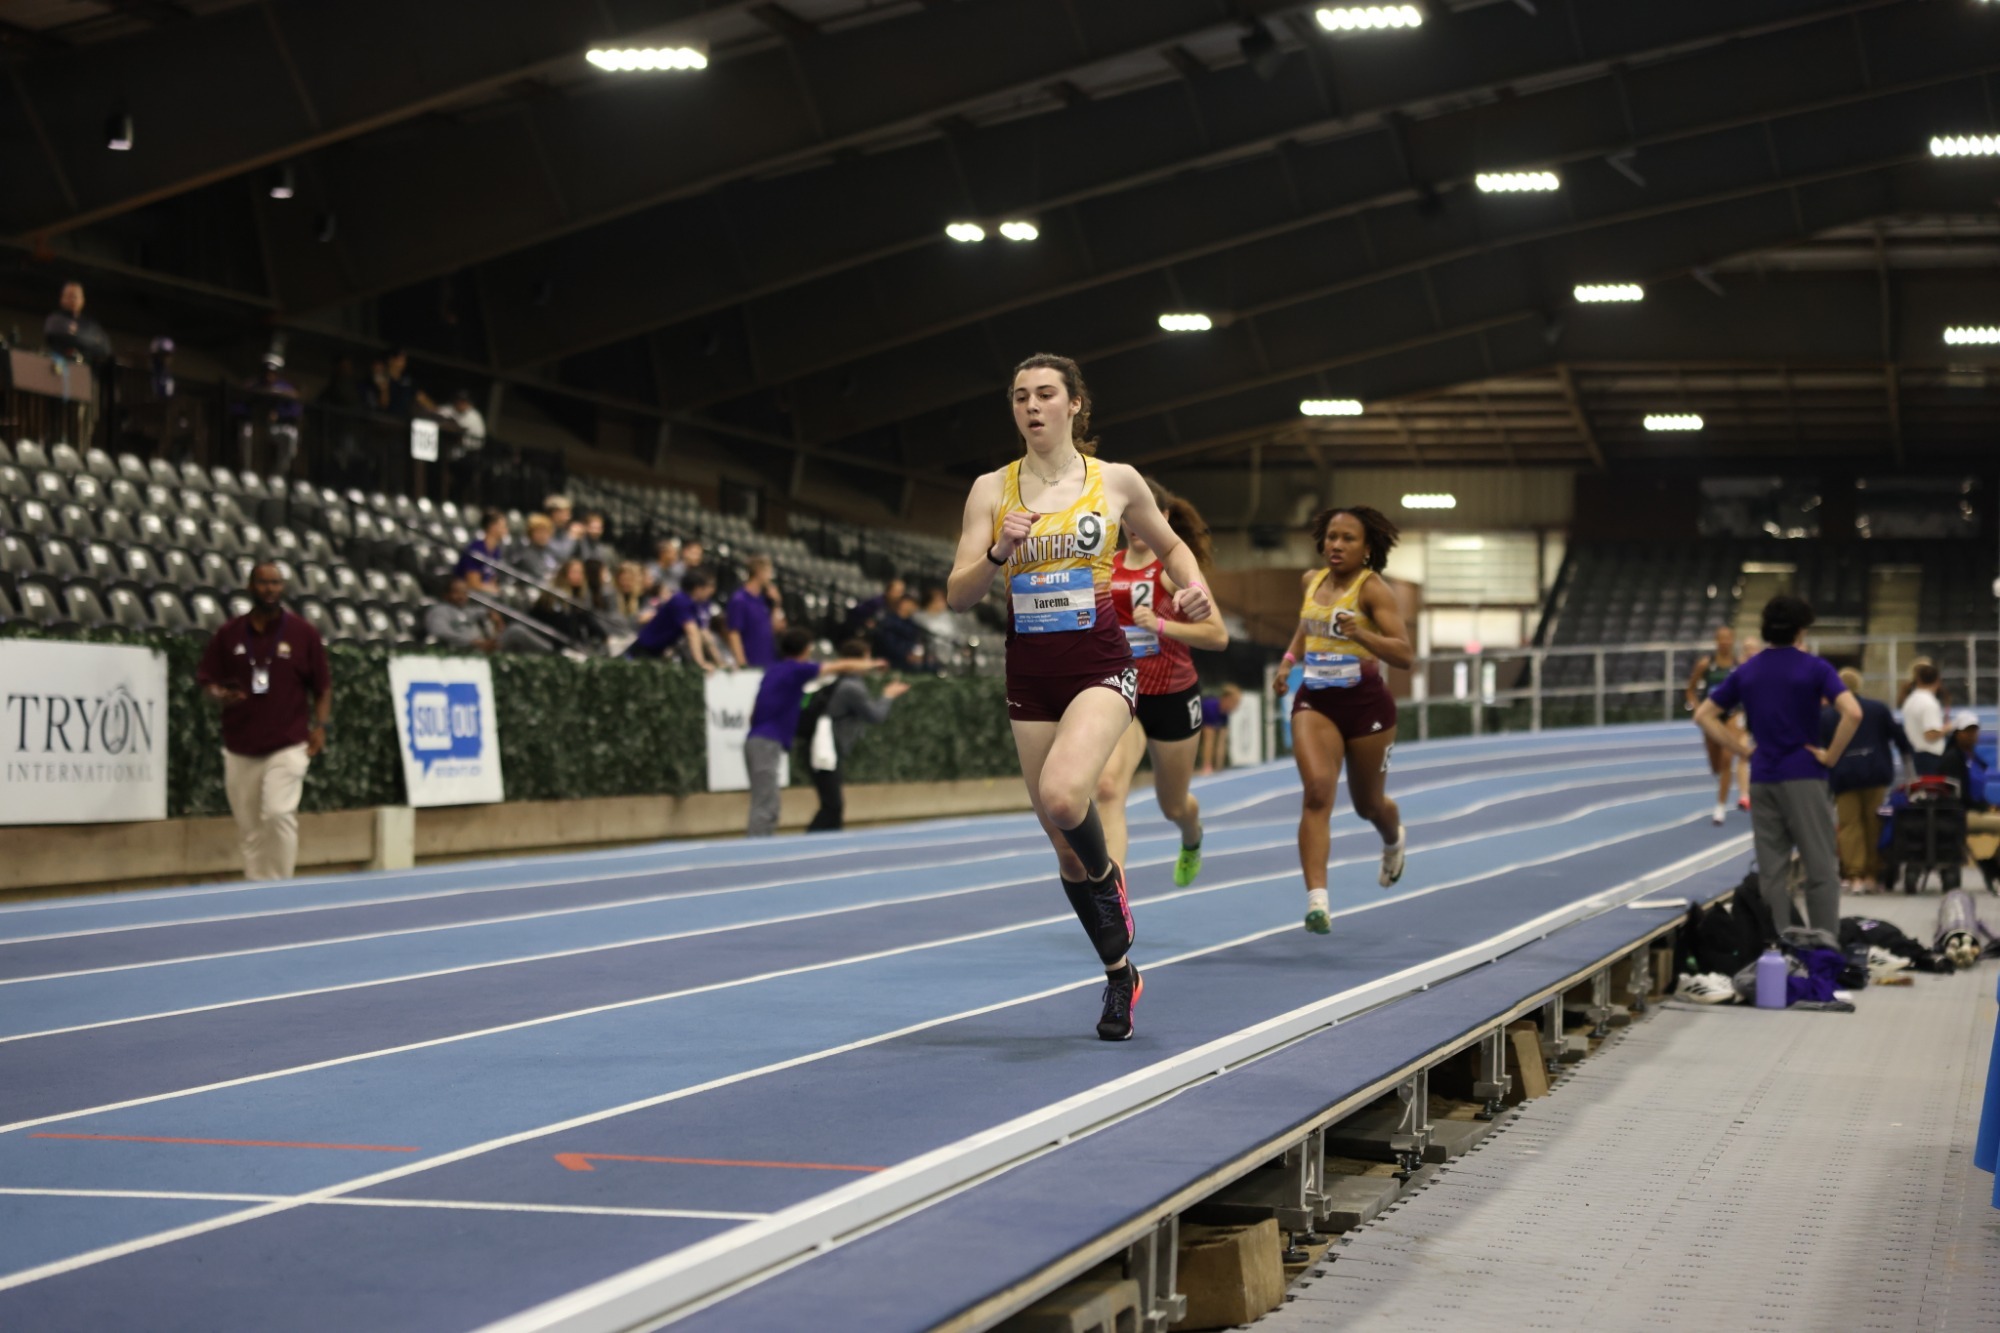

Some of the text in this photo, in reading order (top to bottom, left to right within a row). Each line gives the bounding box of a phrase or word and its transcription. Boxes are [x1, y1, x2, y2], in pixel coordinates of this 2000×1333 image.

[1077, 515, 1101, 551] 9
[1008, 534, 1091, 567] WINTHR
[1034, 597, 1070, 609] Yarema
[1135, 583, 1150, 608] 2
[7, 693, 154, 755] TRYON
[7, 763, 154, 783] INTERNATIONAL
